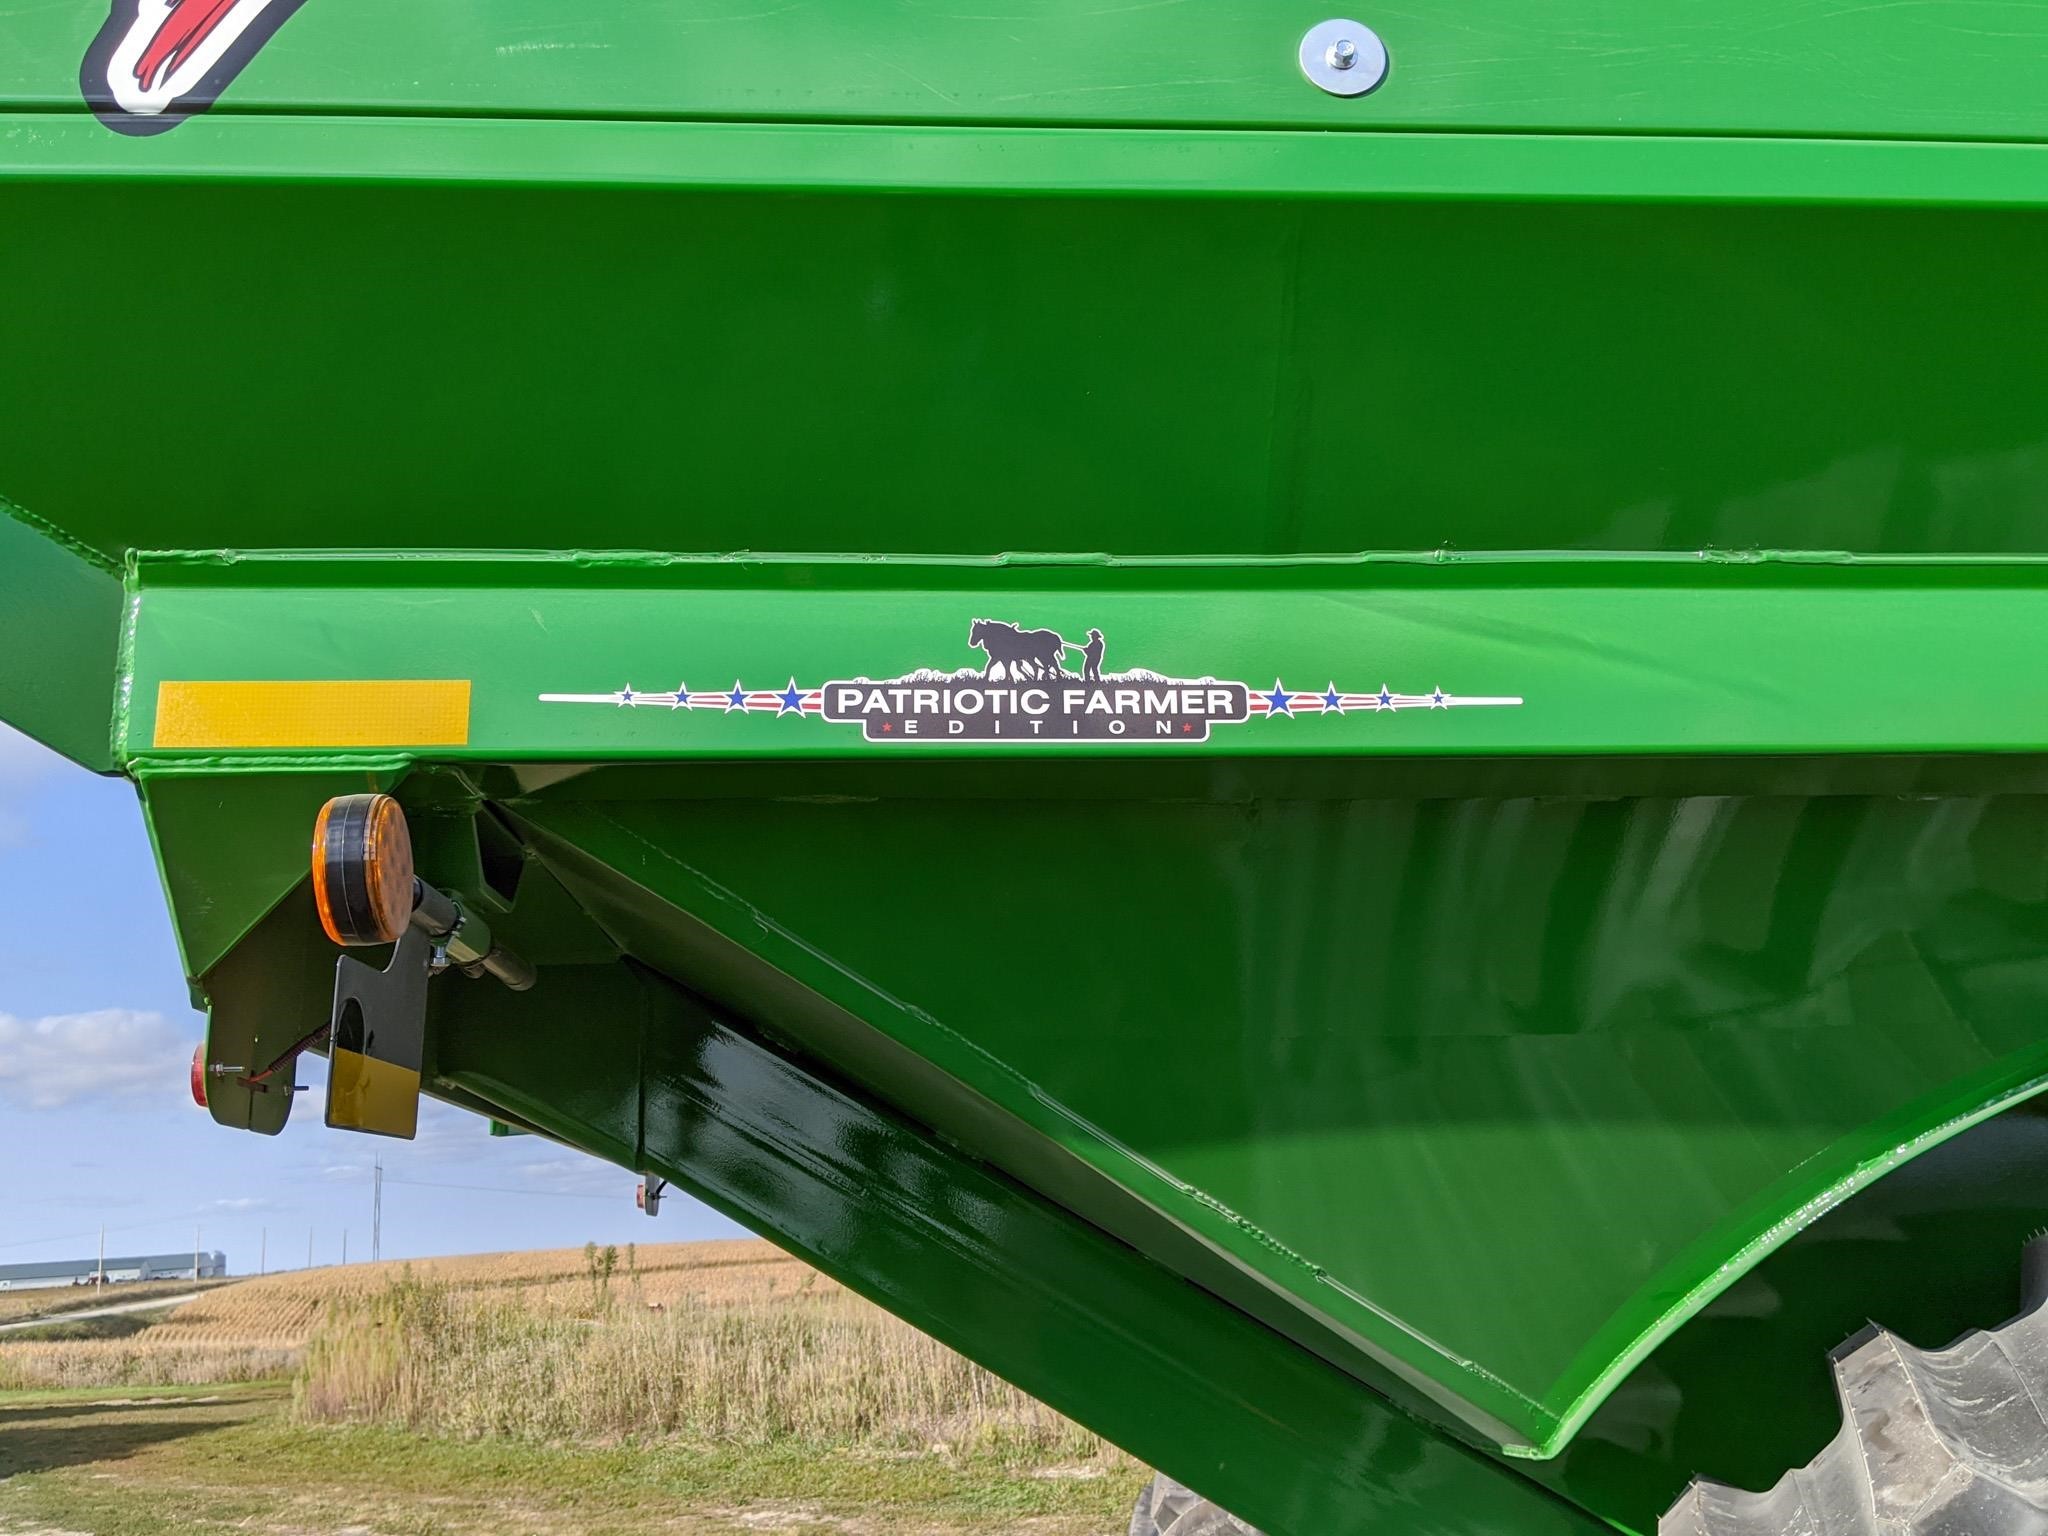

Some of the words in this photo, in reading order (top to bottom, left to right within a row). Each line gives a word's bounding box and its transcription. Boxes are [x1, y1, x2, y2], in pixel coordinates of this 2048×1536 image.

[838, 689, 1050, 715] PATRIOTIC
[1063, 689, 1234, 715] FARMER
[904, 720, 1172, 735] EDITION
